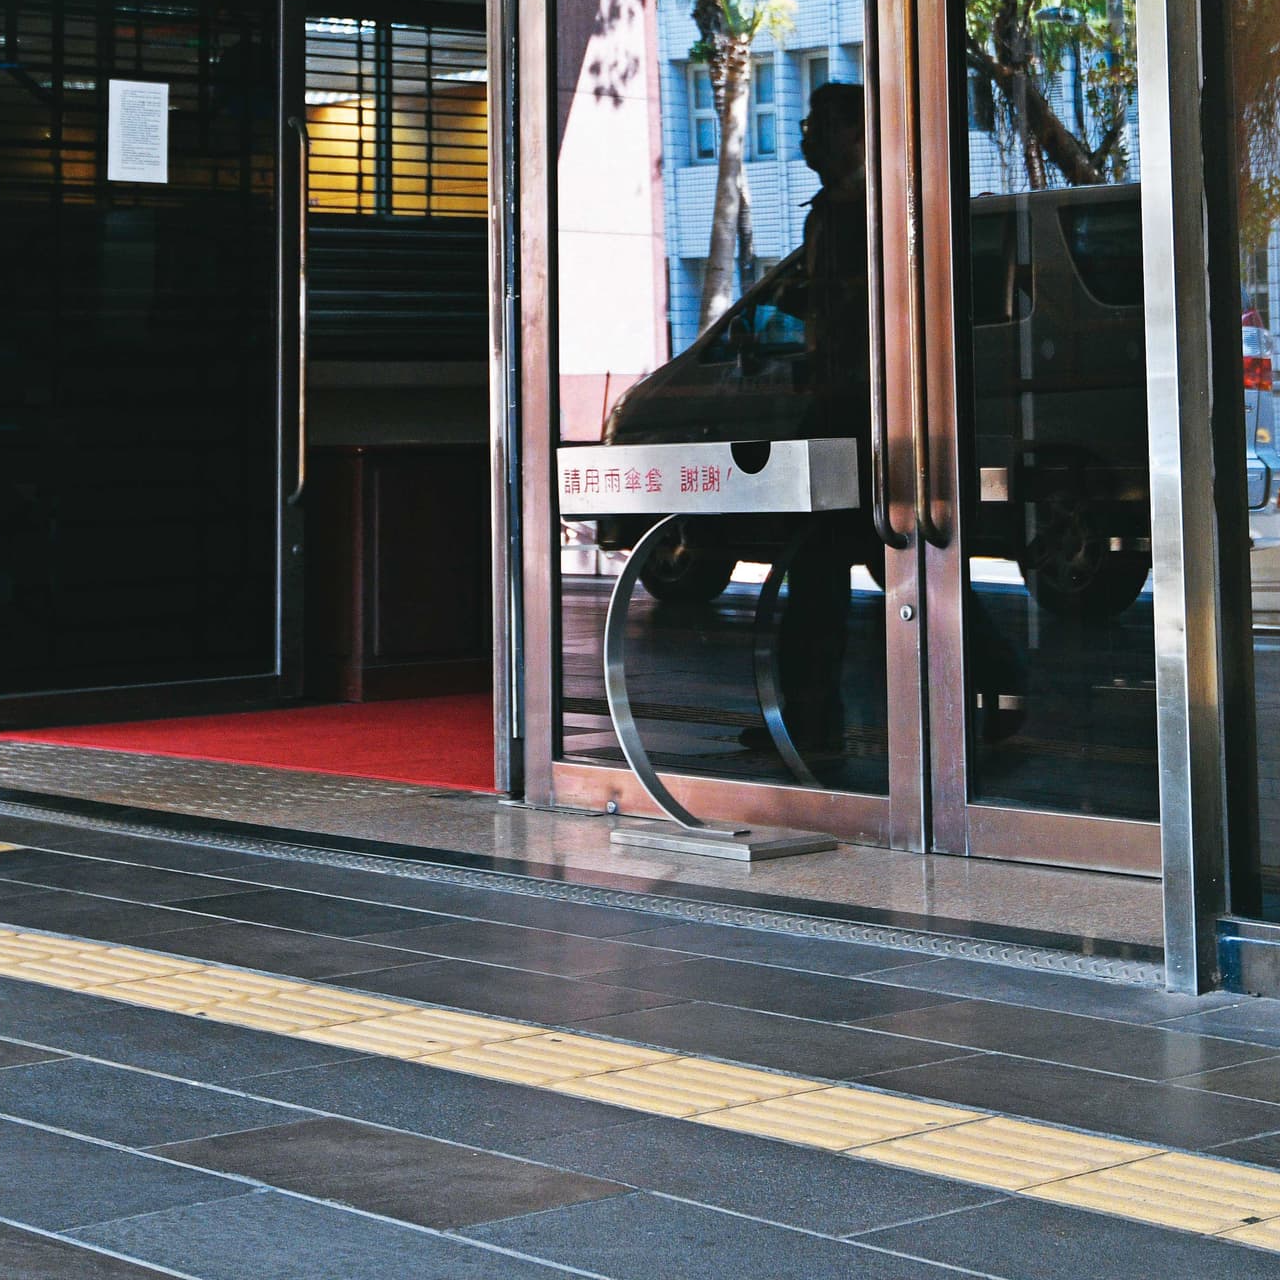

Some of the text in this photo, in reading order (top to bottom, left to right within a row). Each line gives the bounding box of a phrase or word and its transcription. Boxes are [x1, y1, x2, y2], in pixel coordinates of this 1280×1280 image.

[563, 466, 663, 494] 請用雨傘套
